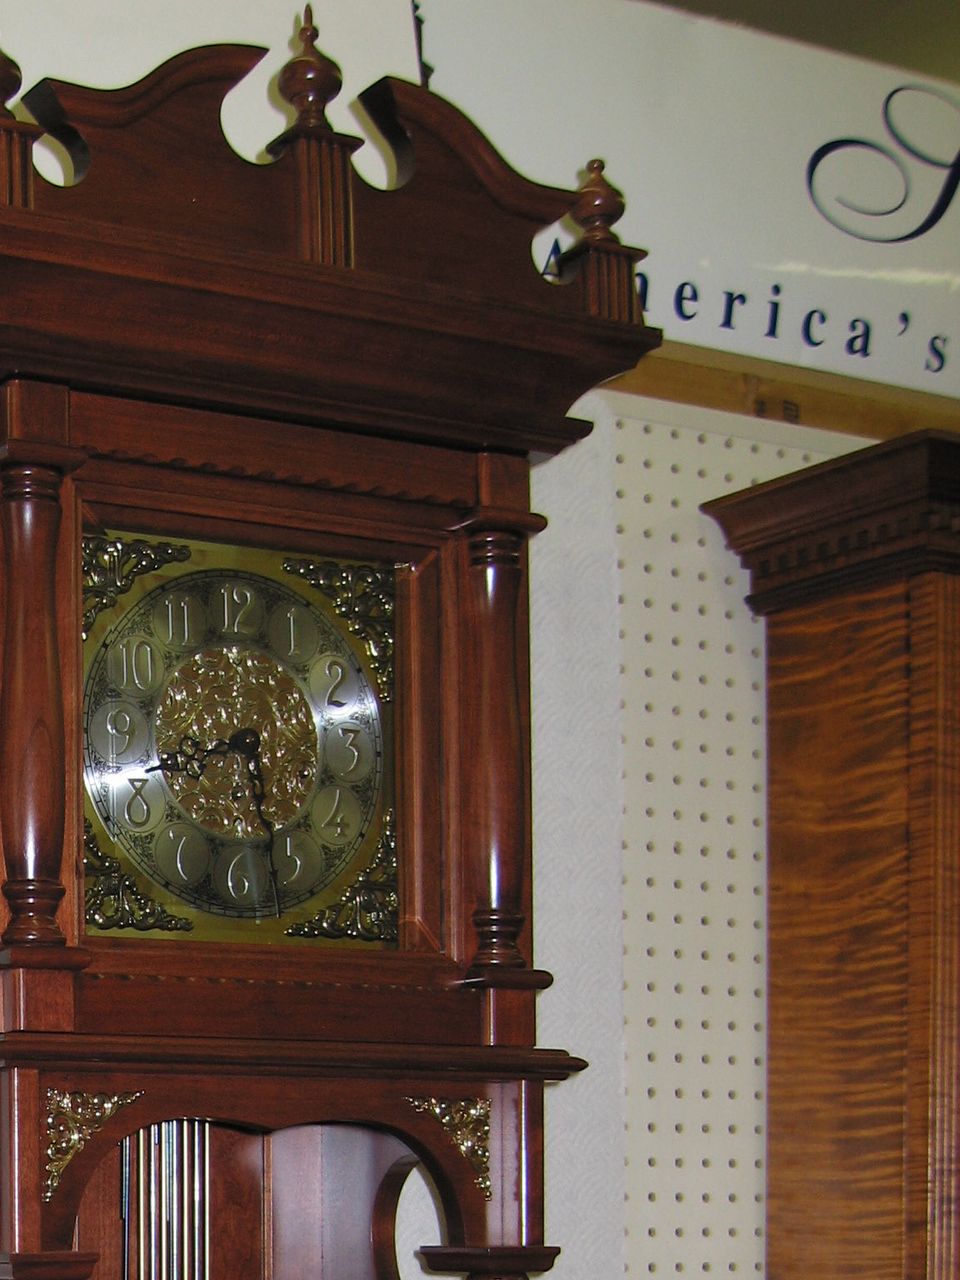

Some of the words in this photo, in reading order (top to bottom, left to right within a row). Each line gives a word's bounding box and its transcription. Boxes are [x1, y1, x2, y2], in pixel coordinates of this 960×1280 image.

[165, 595, 192, 646] 11
[220, 583, 253, 634] 12
[285, 607, 299, 657] 1
[119, 639, 156, 690] 10
[324, 659, 348, 708] 2
[106, 707, 134, 757] 9
[339, 727, 361, 777] 3
[124, 777, 151, 829] 8
[226, 850, 250, 899] 6
[282, 835, 303, 885] 5
